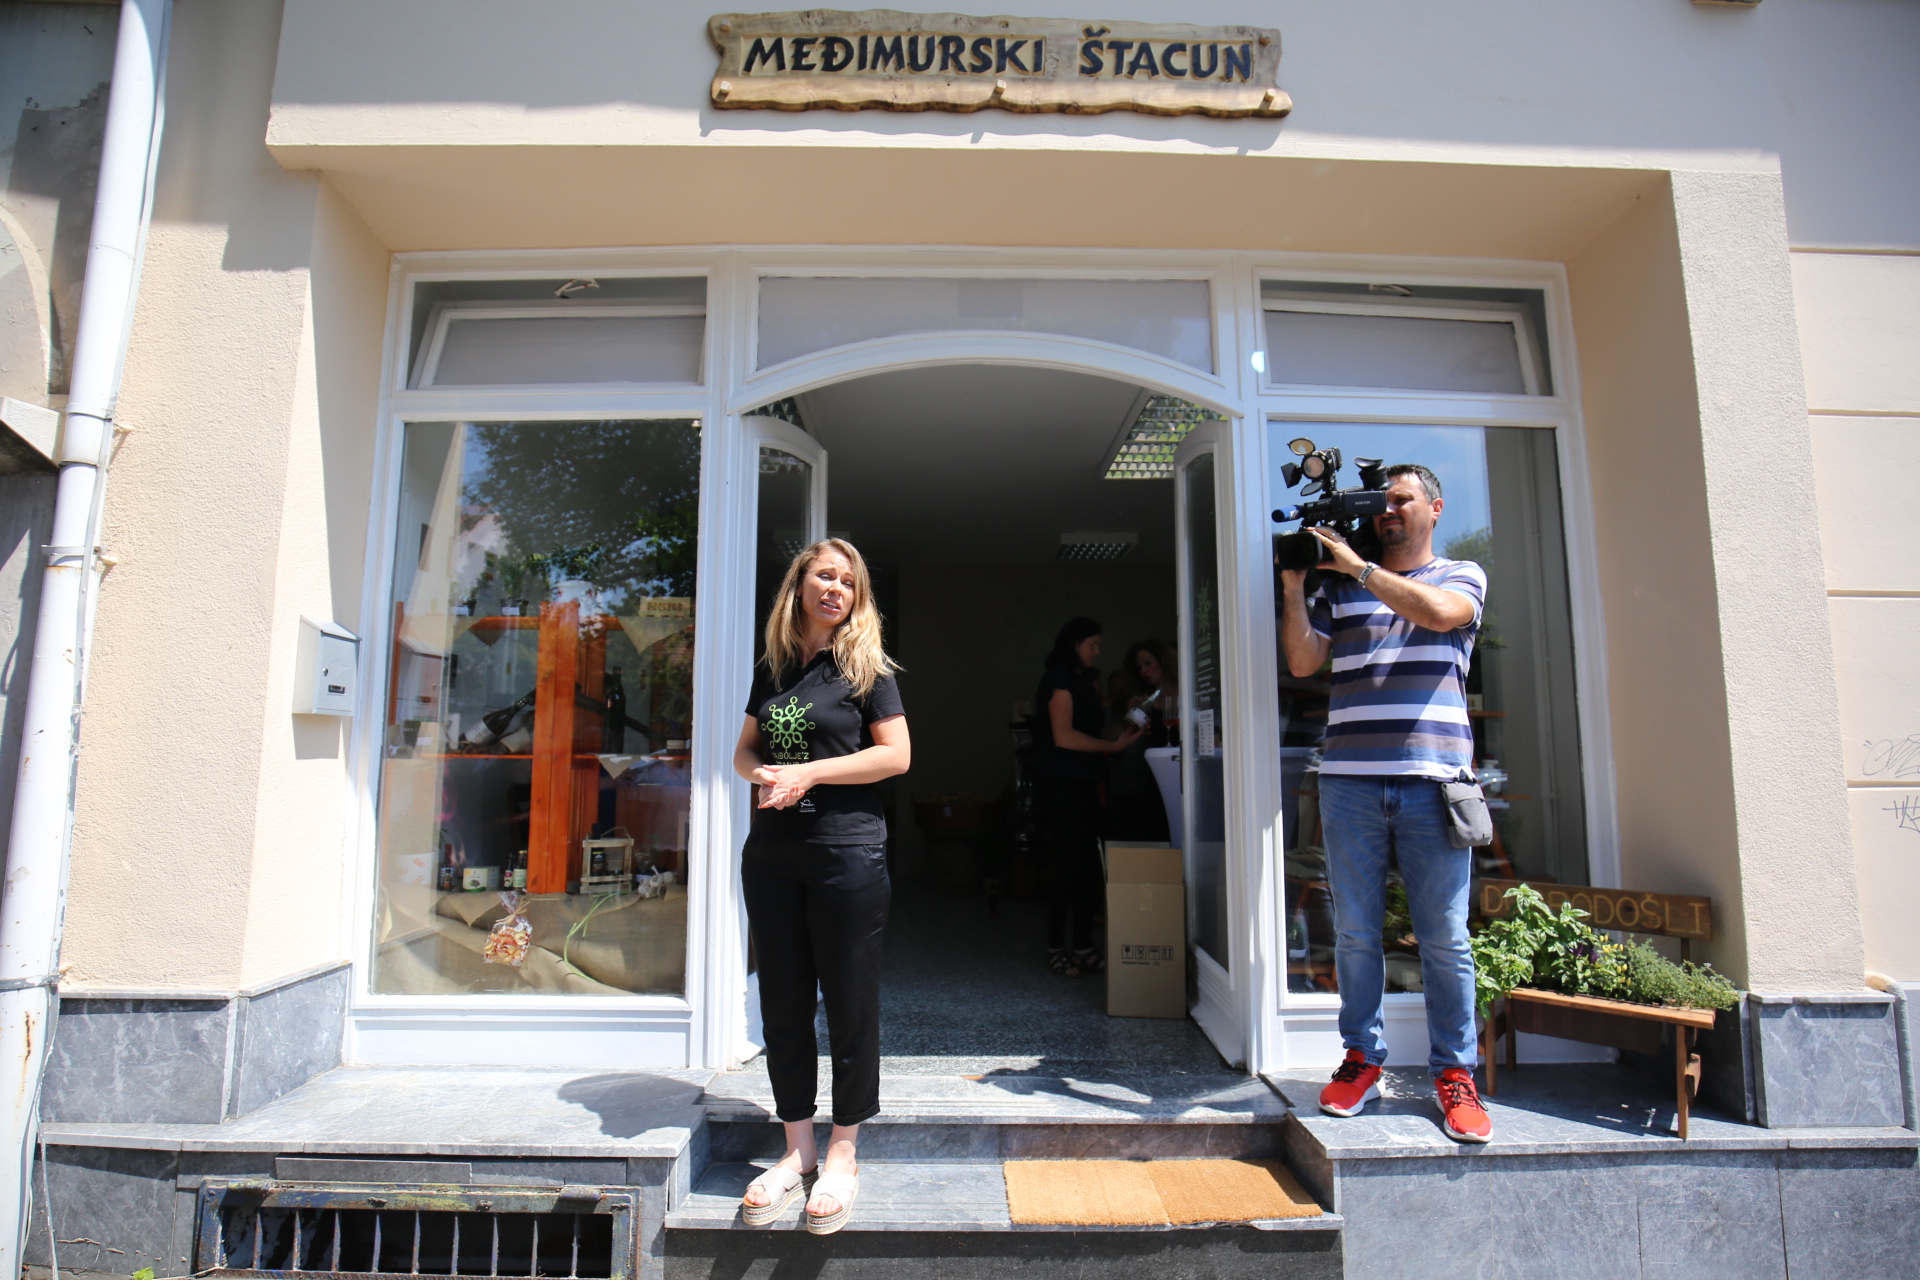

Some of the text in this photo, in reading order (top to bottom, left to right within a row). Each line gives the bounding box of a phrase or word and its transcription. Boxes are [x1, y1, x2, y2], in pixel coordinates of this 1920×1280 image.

[742, 25, 1252, 80] MEĐIMURSKI ŠTACUN
[1483, 884, 1706, 935] DRODOŠLI
